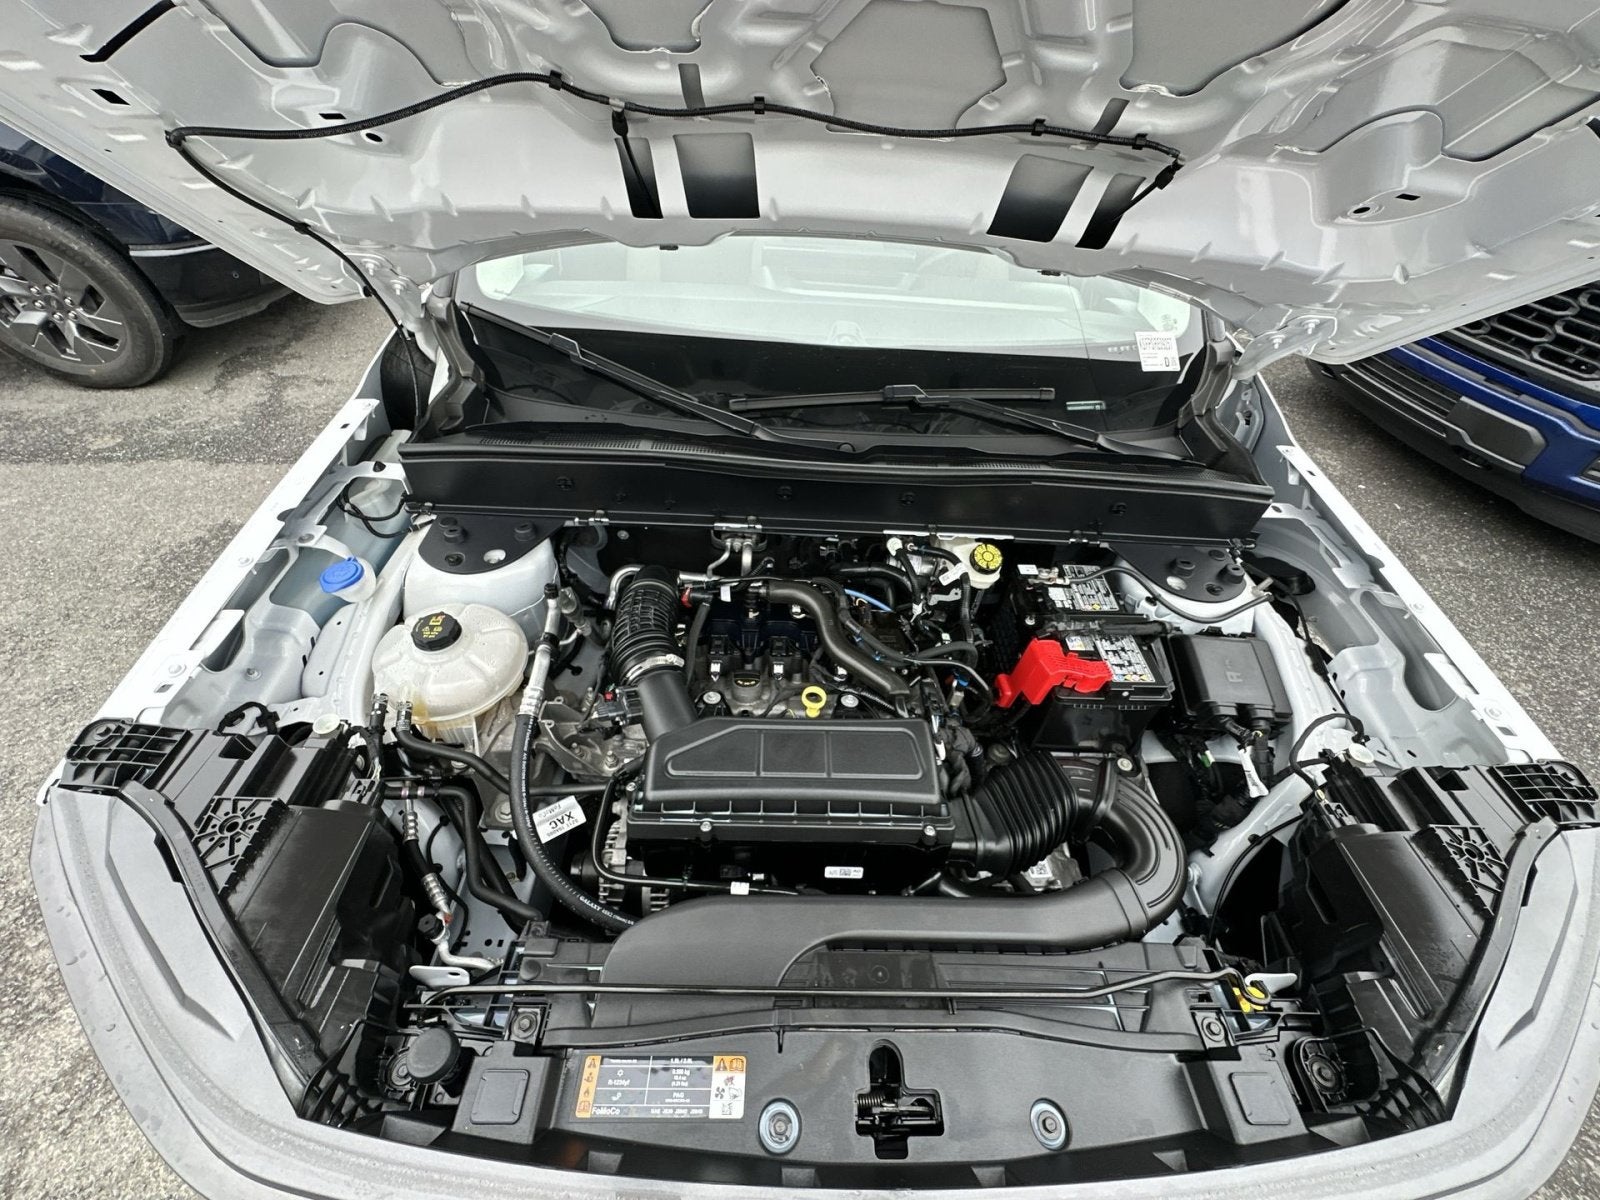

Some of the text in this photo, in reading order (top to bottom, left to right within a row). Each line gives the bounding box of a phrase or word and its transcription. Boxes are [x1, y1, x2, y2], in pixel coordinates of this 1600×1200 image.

[549, 811, 574, 829] XAC
[580, 895, 602, 911] GALAXY
[591, 1106, 620, 1115] FoMoCo
